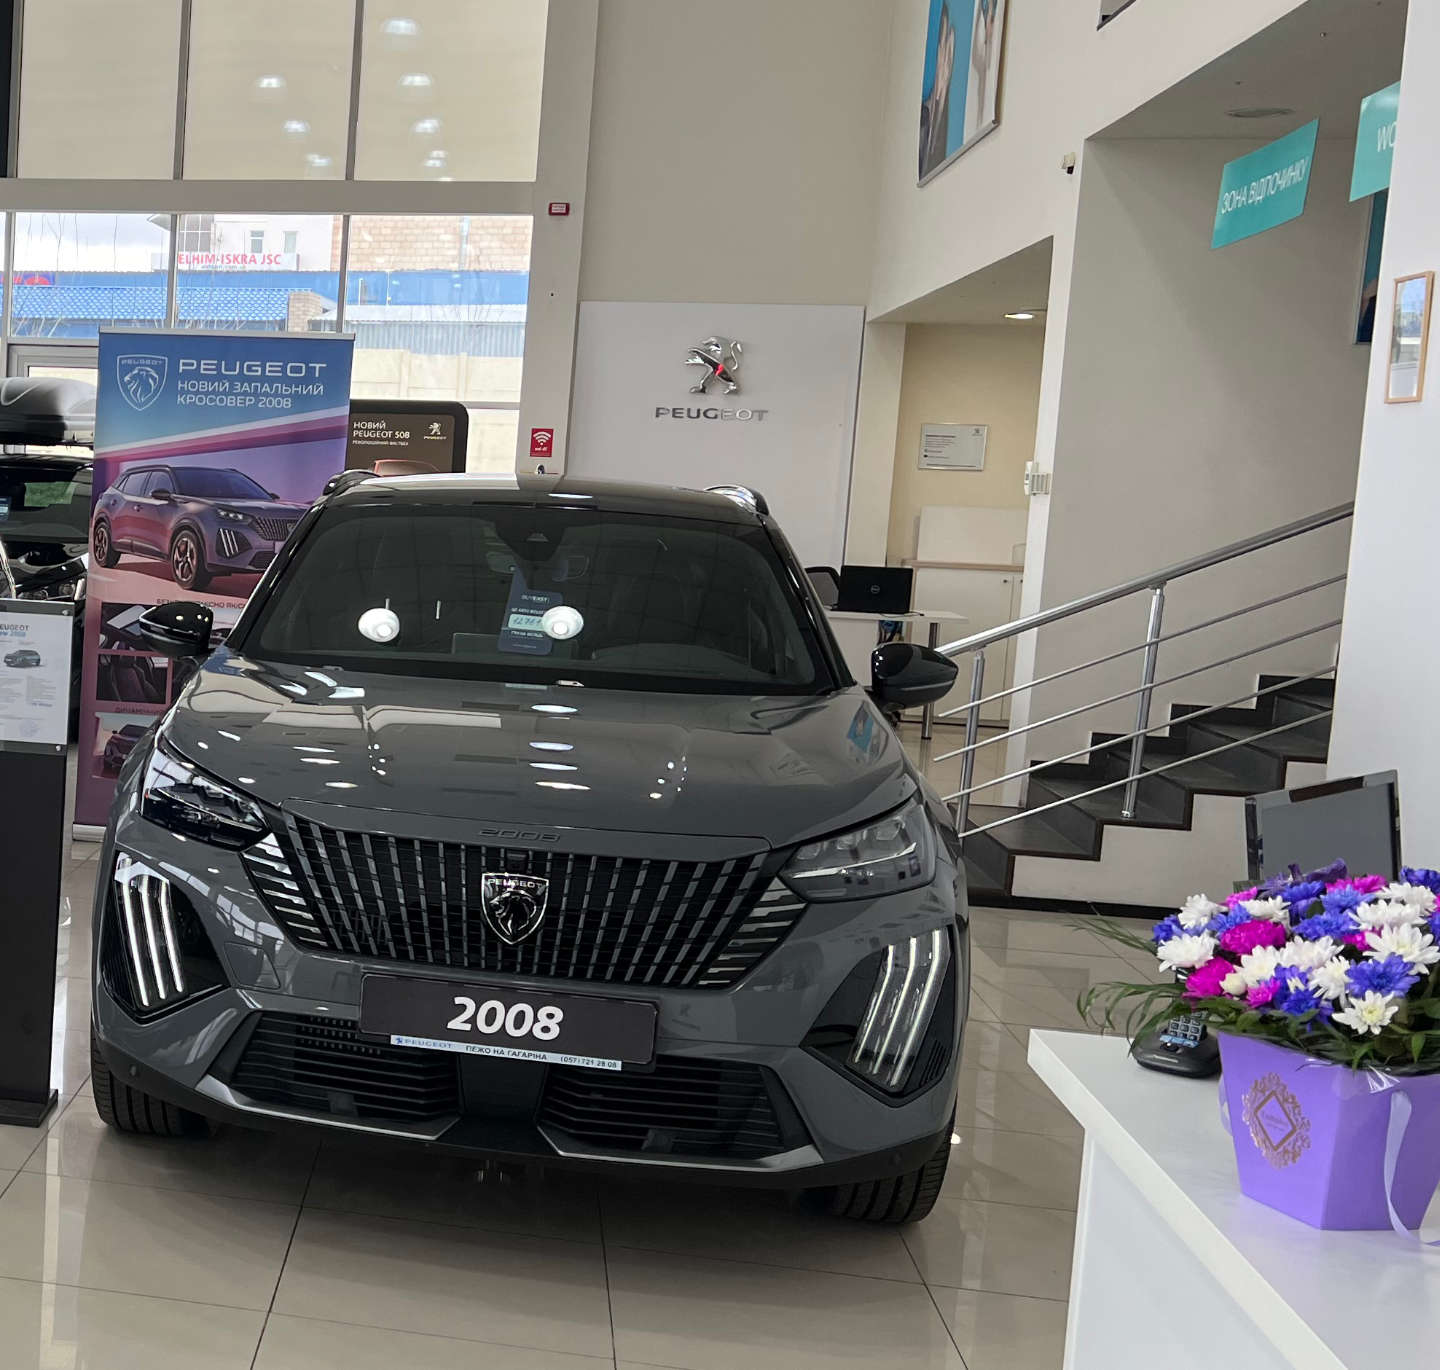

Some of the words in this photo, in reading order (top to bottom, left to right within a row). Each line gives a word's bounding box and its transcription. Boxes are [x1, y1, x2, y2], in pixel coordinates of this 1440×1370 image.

[1221, 184, 1248, 215] ЗОНА
[1247, 156, 1310, 205] ВІДПОЧИНКУ
[260, 253, 281, 265] JSC
[178, 359, 327, 378] PEUGEOT
[177, 379, 229, 393] НОВИЙ
[232, 381, 324, 396] ЗАПАЛЬНИЙ
[176, 394, 255, 407] КРОСОВЕР
[258, 397, 292, 409] 2008
[655, 407, 768, 421] PEUGEOT
[352, 420, 386, 430] НОВИЙ
[352, 430, 393, 439] PEUGEOT
[394, 431, 410, 439] 508
[479, 828, 561, 842] 2008
[487, 878, 543, 889] PEUGEOT
[447, 996, 564, 1040] 2008
[405, 1038, 453, 1049] PEUGEOT
[465, 1045, 491, 1055] ПЕЖО
[493, 1048, 505, 1056] НА
[507, 1049, 547, 1060] ГАГАРІНА
